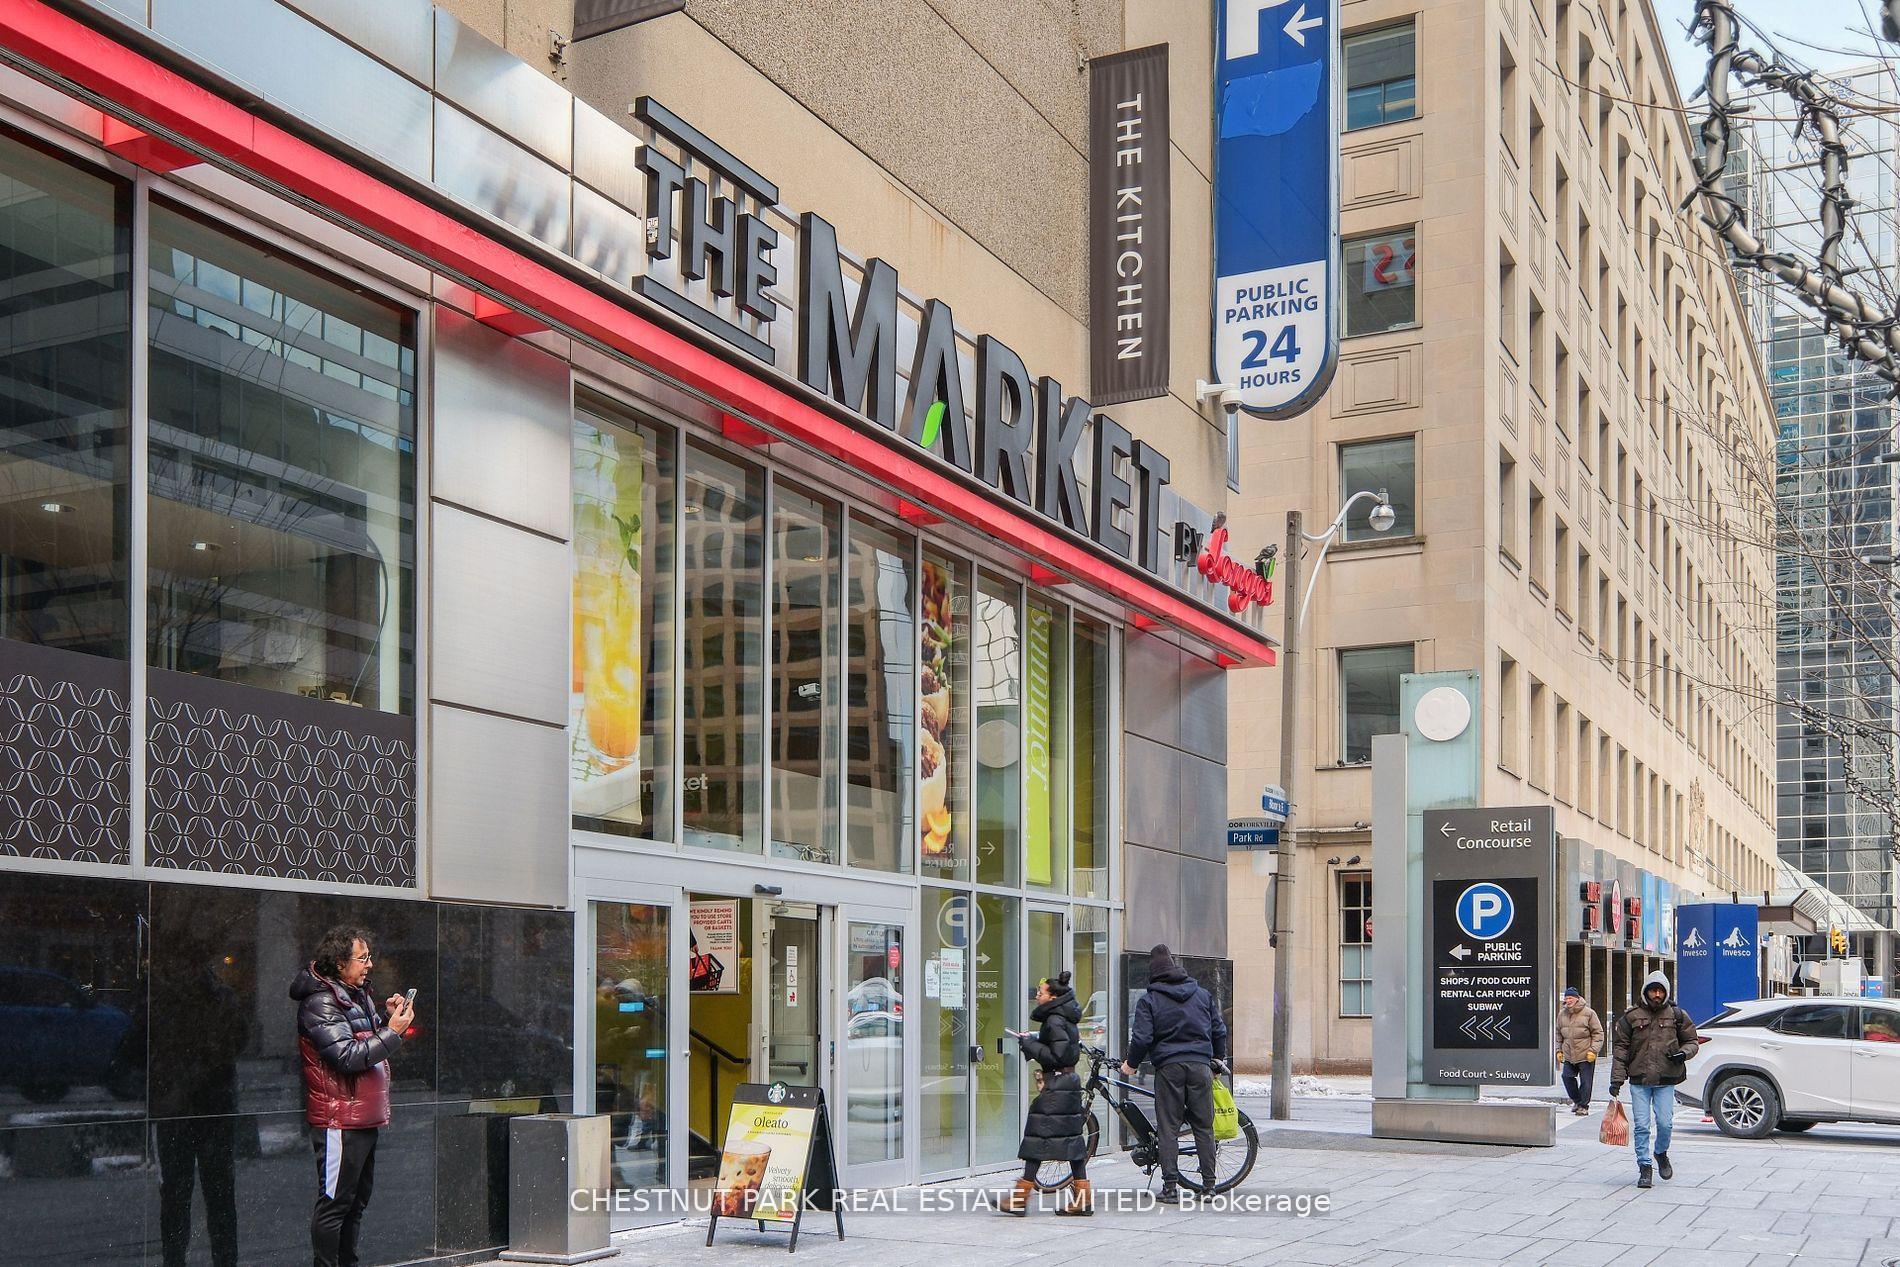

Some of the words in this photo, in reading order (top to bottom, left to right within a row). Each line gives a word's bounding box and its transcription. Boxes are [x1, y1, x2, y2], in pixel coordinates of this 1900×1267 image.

[1116, 92, 1142, 168] THE
[635, 144, 778, 323] THE
[1116, 186, 1143, 360] KITCHEN
[1236, 278, 1309, 304] PUBLIC
[1225, 295, 1319, 324] PARKING
[1240, 324, 1302, 371] 24
[1240, 368, 1301, 390] HOURS
[798, 211, 1171, 574] MARKET
[1175, 521, 1204, 567] BY
[1030, 608, 1048, 792] summer
[1490, 818, 1532, 833] Retail
[1233, 832, 1252, 843] Park
[1254, 834, 1264, 842] Rd
[1456, 837, 1532, 850] Concourse
[1472, 893, 1502, 930] P
[1484, 943, 1522, 952] PUBLIC
[1682, 949, 1708, 957] Invesco
[1722, 949, 1751, 957] Invesco
[1477, 952, 1522, 961] PARKING
[1440, 977, 1470, 986] SHOPS
[1476, 977, 1500, 985] FOOD
[1501, 976, 1532, 985] COURT
[1440, 990, 1473, 998] RENTAL
[1475, 990, 1494, 998] CAR
[1495, 989, 1531, 998] PICK-UP
[1467, 1002, 1504, 1011] SUBWAY
[1439, 1070, 1461, 1079] Food
[1462, 1070, 1487, 1079] Court
[1495, 1070, 1531, 1082] Subway
[753, 1116, 789, 1129] Oleato
